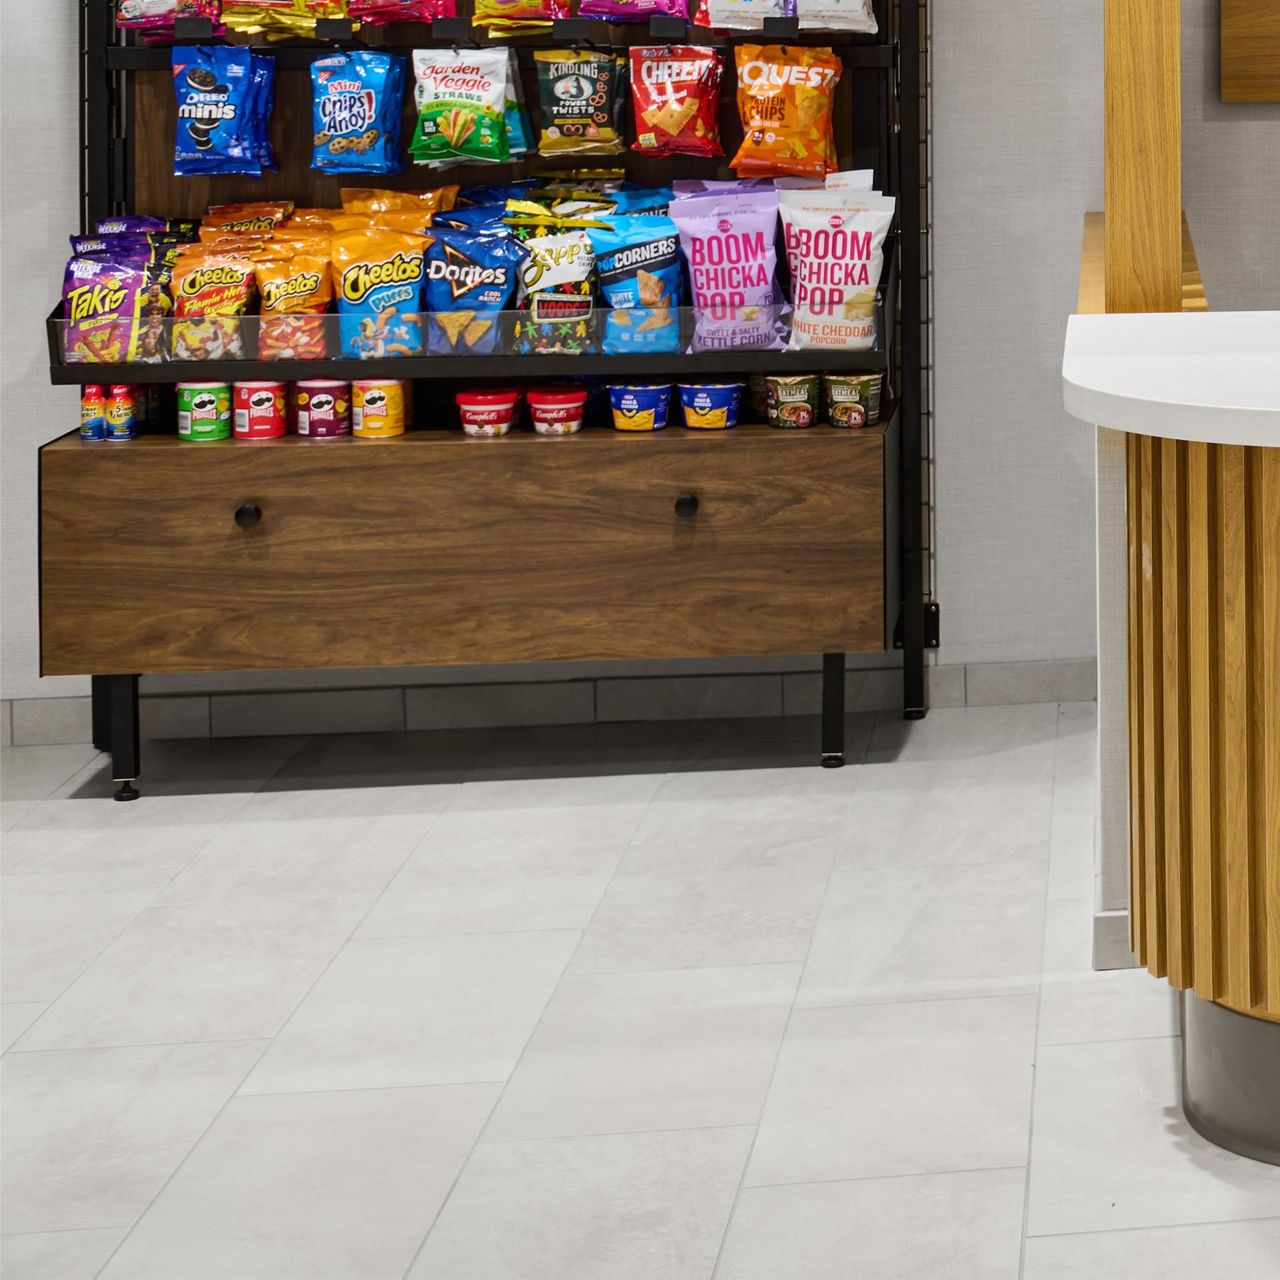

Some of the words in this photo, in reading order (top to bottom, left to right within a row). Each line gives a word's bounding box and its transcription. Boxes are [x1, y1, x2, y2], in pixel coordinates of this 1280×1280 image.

[419, 62, 480, 81] garden
[549, 62, 598, 79] KINDLING
[743, 61, 835, 88] QUEST
[328, 80, 361, 93] Mini
[432, 74, 492, 92] Veggie
[186, 92, 229, 104] OREO
[433, 91, 483, 102] STRAWS
[178, 102, 236, 120] minis
[552, 106, 595, 114] TWISTS
[749, 106, 786, 121] CHIPS
[691, 231, 767, 266] BOOM
[798, 228, 873, 261] BOOM
[182, 265, 245, 296] Cheetos
[343, 252, 423, 302] Cheetos
[428, 260, 507, 285] Doritos
[693, 264, 769, 291] CHICKA
[799, 258, 870, 286] CHICKA
[262, 272, 320, 309] Cheetos
[369, 286, 413, 312] PUFFS
[797, 283, 844, 316] POP
[68, 282, 129, 327] Takis
[695, 291, 746, 321] POP
[706, 328, 731, 336] SWEET
[738, 326, 760, 335] SALTY
[793, 318, 819, 336] WHITE
[822, 324, 873, 337] CHEDDAR
[697, 335, 738, 348] KETTLE
[740, 331, 772, 346] CORN
[810, 335, 847, 345] POPCORN
[465, 411, 498, 421] Campbell's
[536, 409, 567, 419] Campbell's
